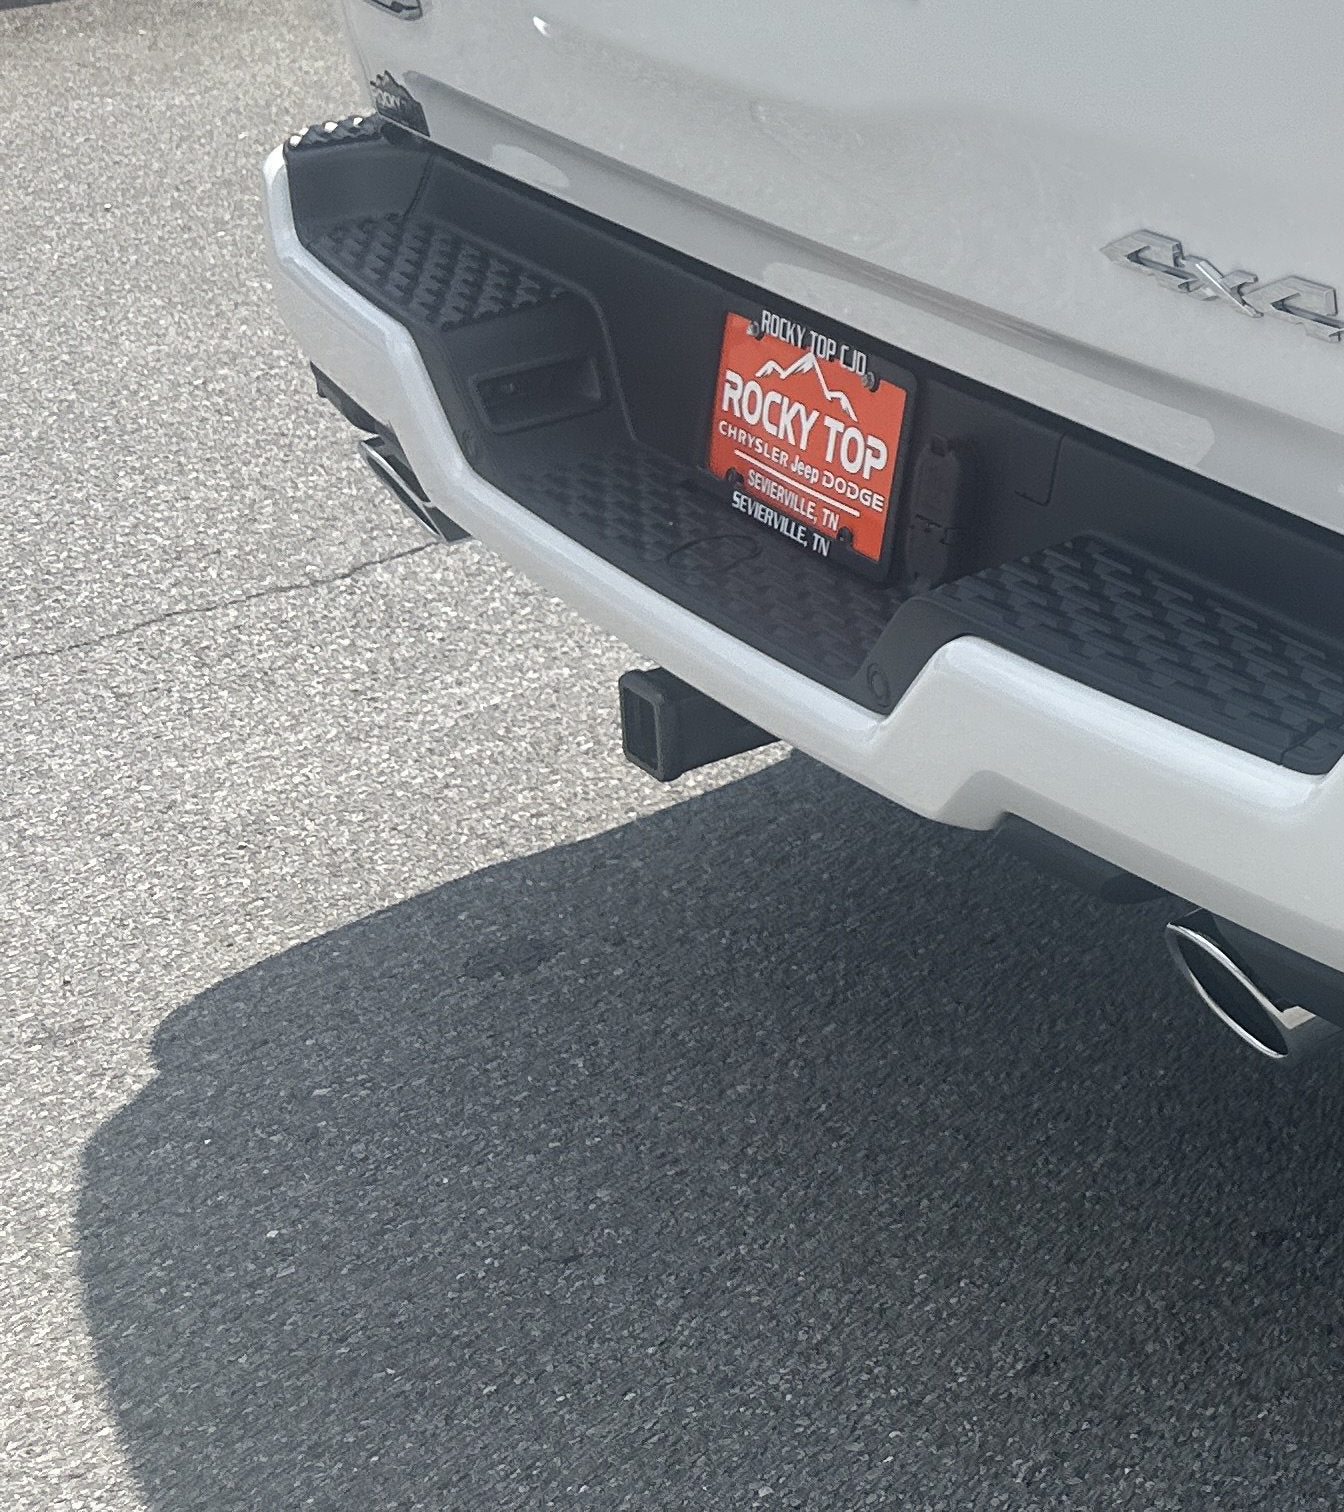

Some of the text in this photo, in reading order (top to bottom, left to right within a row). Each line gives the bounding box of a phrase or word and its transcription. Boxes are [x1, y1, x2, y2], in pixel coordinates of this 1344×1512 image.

[761, 309, 867, 376] ROCKY TOP CJD
[721, 369, 888, 480] ROCKY TOP
[718, 420, 886, 513] CHRYSLER Jeep DODGE
[747, 469, 840, 531] SEVIERVILLE, TN
[731, 490, 831, 557] SEVIERVILLE, TN
